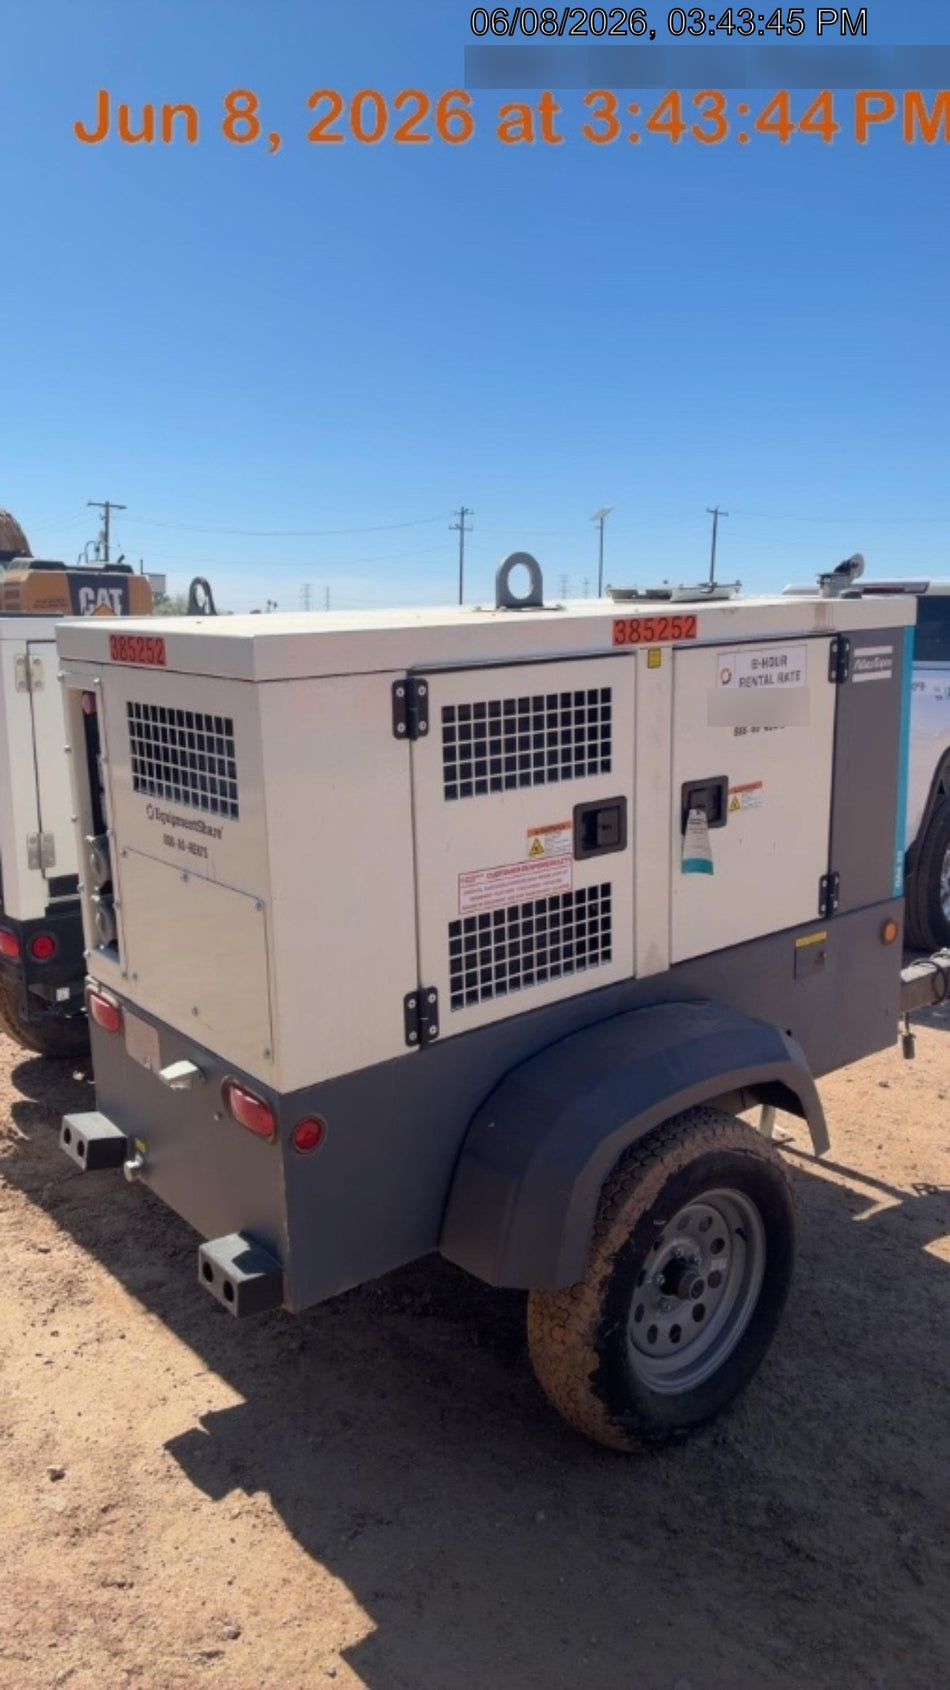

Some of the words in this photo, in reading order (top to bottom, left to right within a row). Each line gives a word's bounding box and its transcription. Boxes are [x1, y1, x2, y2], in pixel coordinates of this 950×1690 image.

[79, 587, 123, 616] CAT
[614, 615, 696, 644] 385252
[110, 634, 165, 664] 385252
[777, 670, 801, 683] RATE
